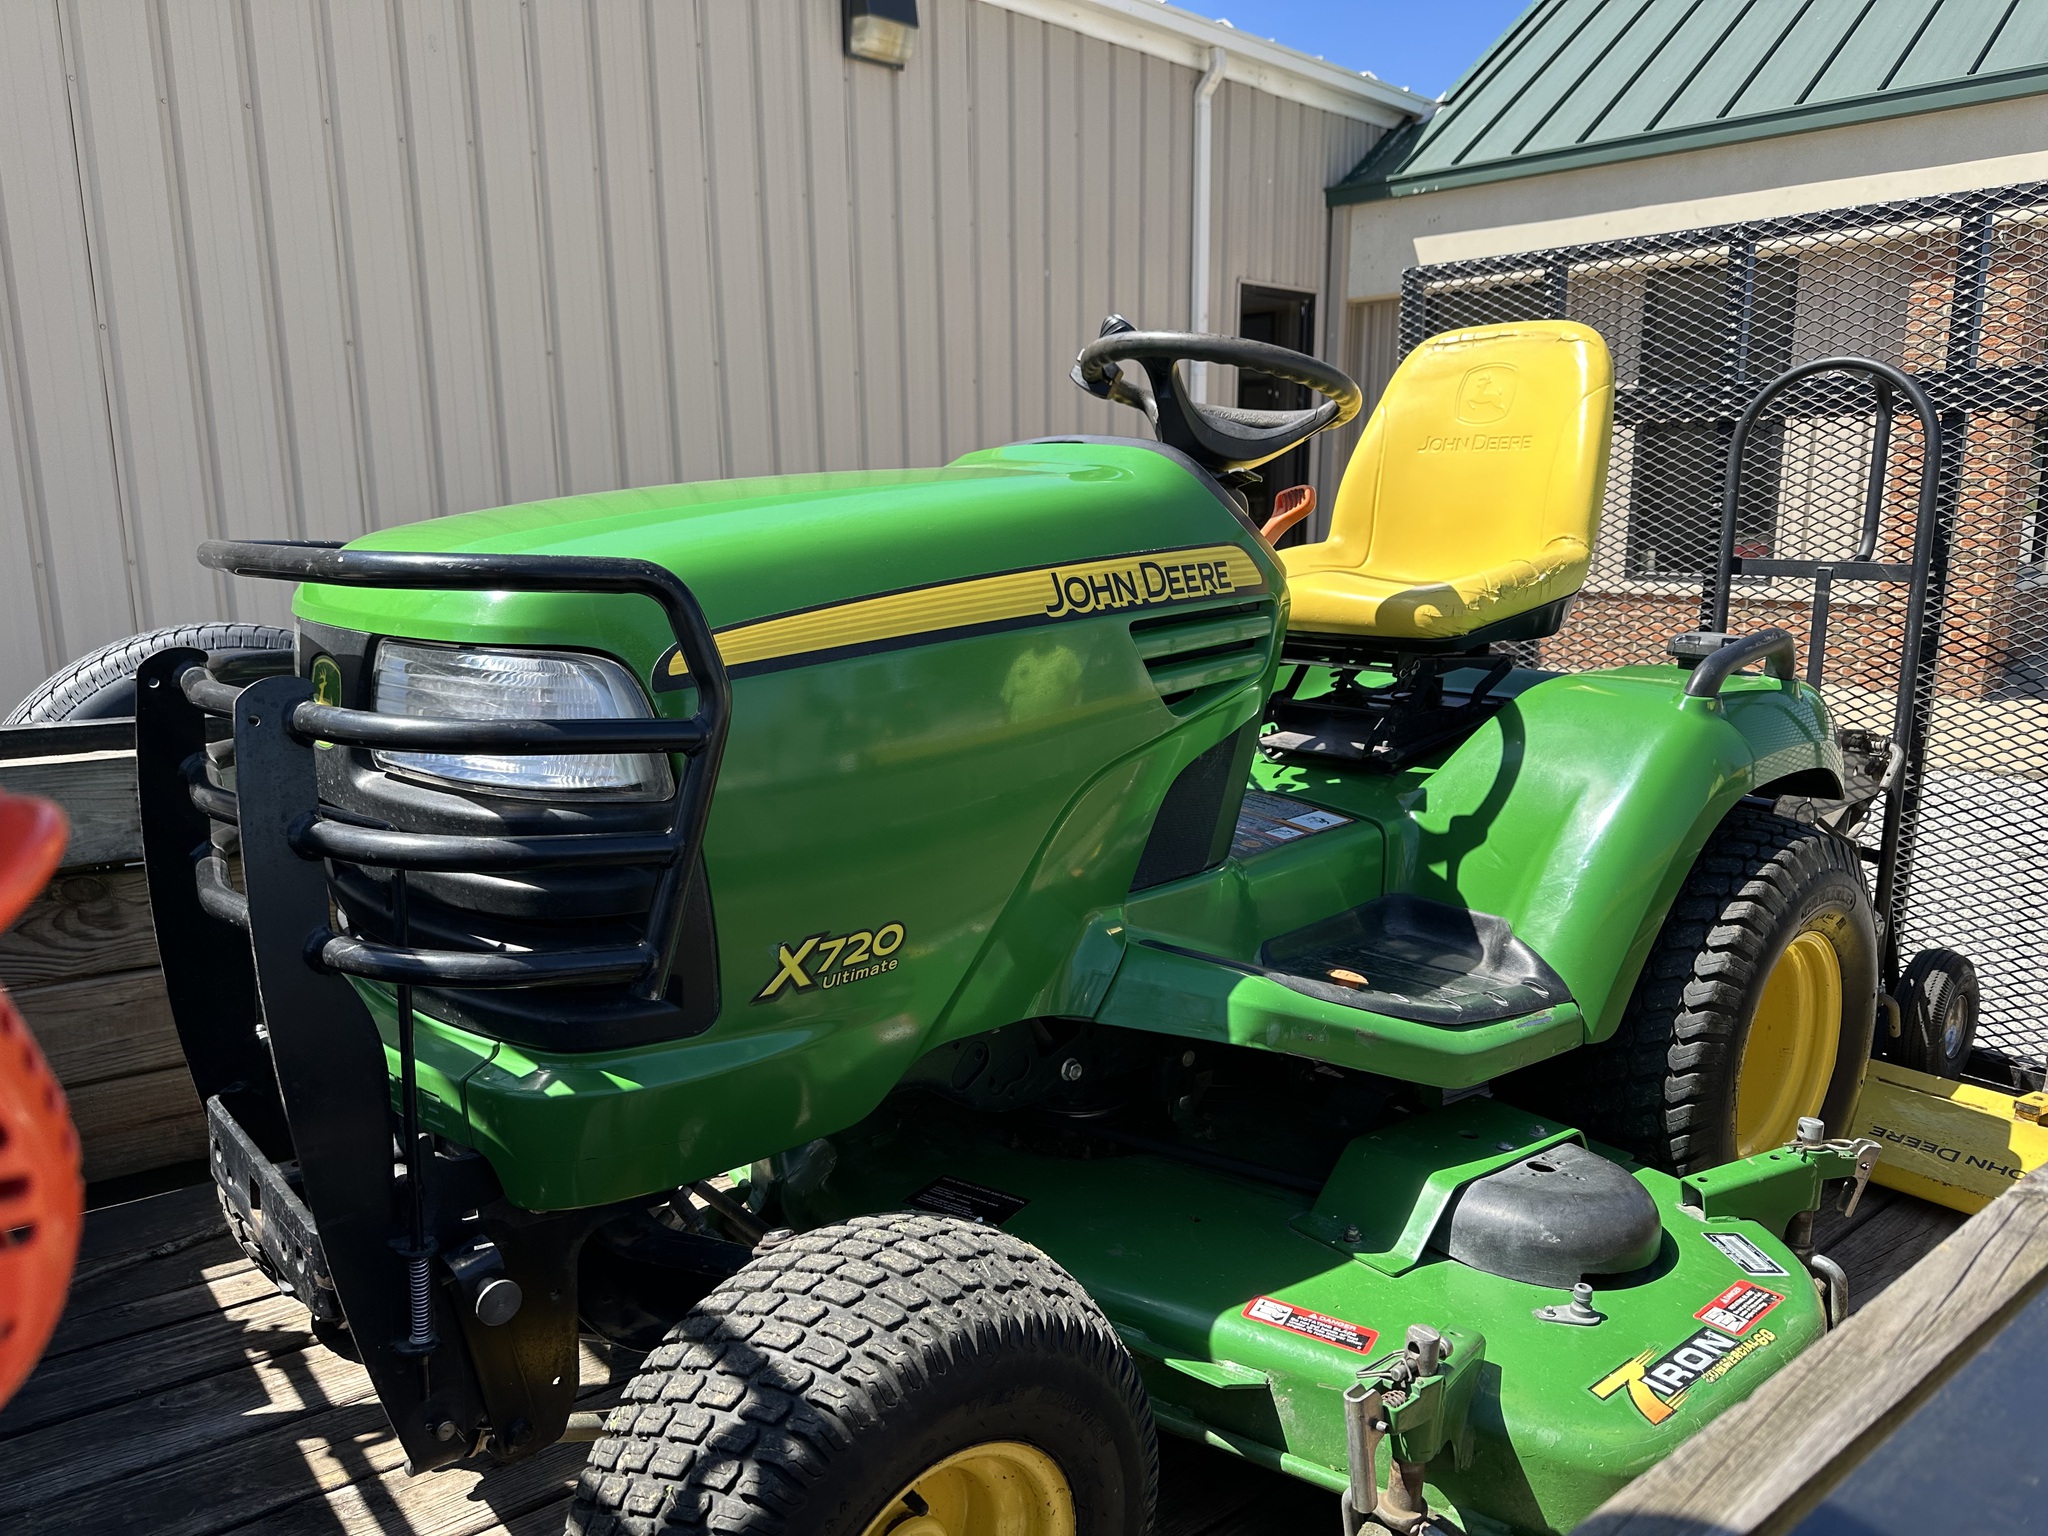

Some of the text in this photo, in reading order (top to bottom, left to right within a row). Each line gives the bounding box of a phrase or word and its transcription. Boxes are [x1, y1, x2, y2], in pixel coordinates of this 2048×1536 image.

[1417, 434, 1533, 453] JOHN DEERE
[1046, 561, 1234, 616] JOHN DEERE
[754, 921, 905, 1003] X720
[822, 958, 899, 990] Ultimate
[1868, 1125, 2028, 1180] OHN DEERE
[1318, 1315, 1357, 1331] DANGER
[1640, 1330, 1736, 1397] IRON
